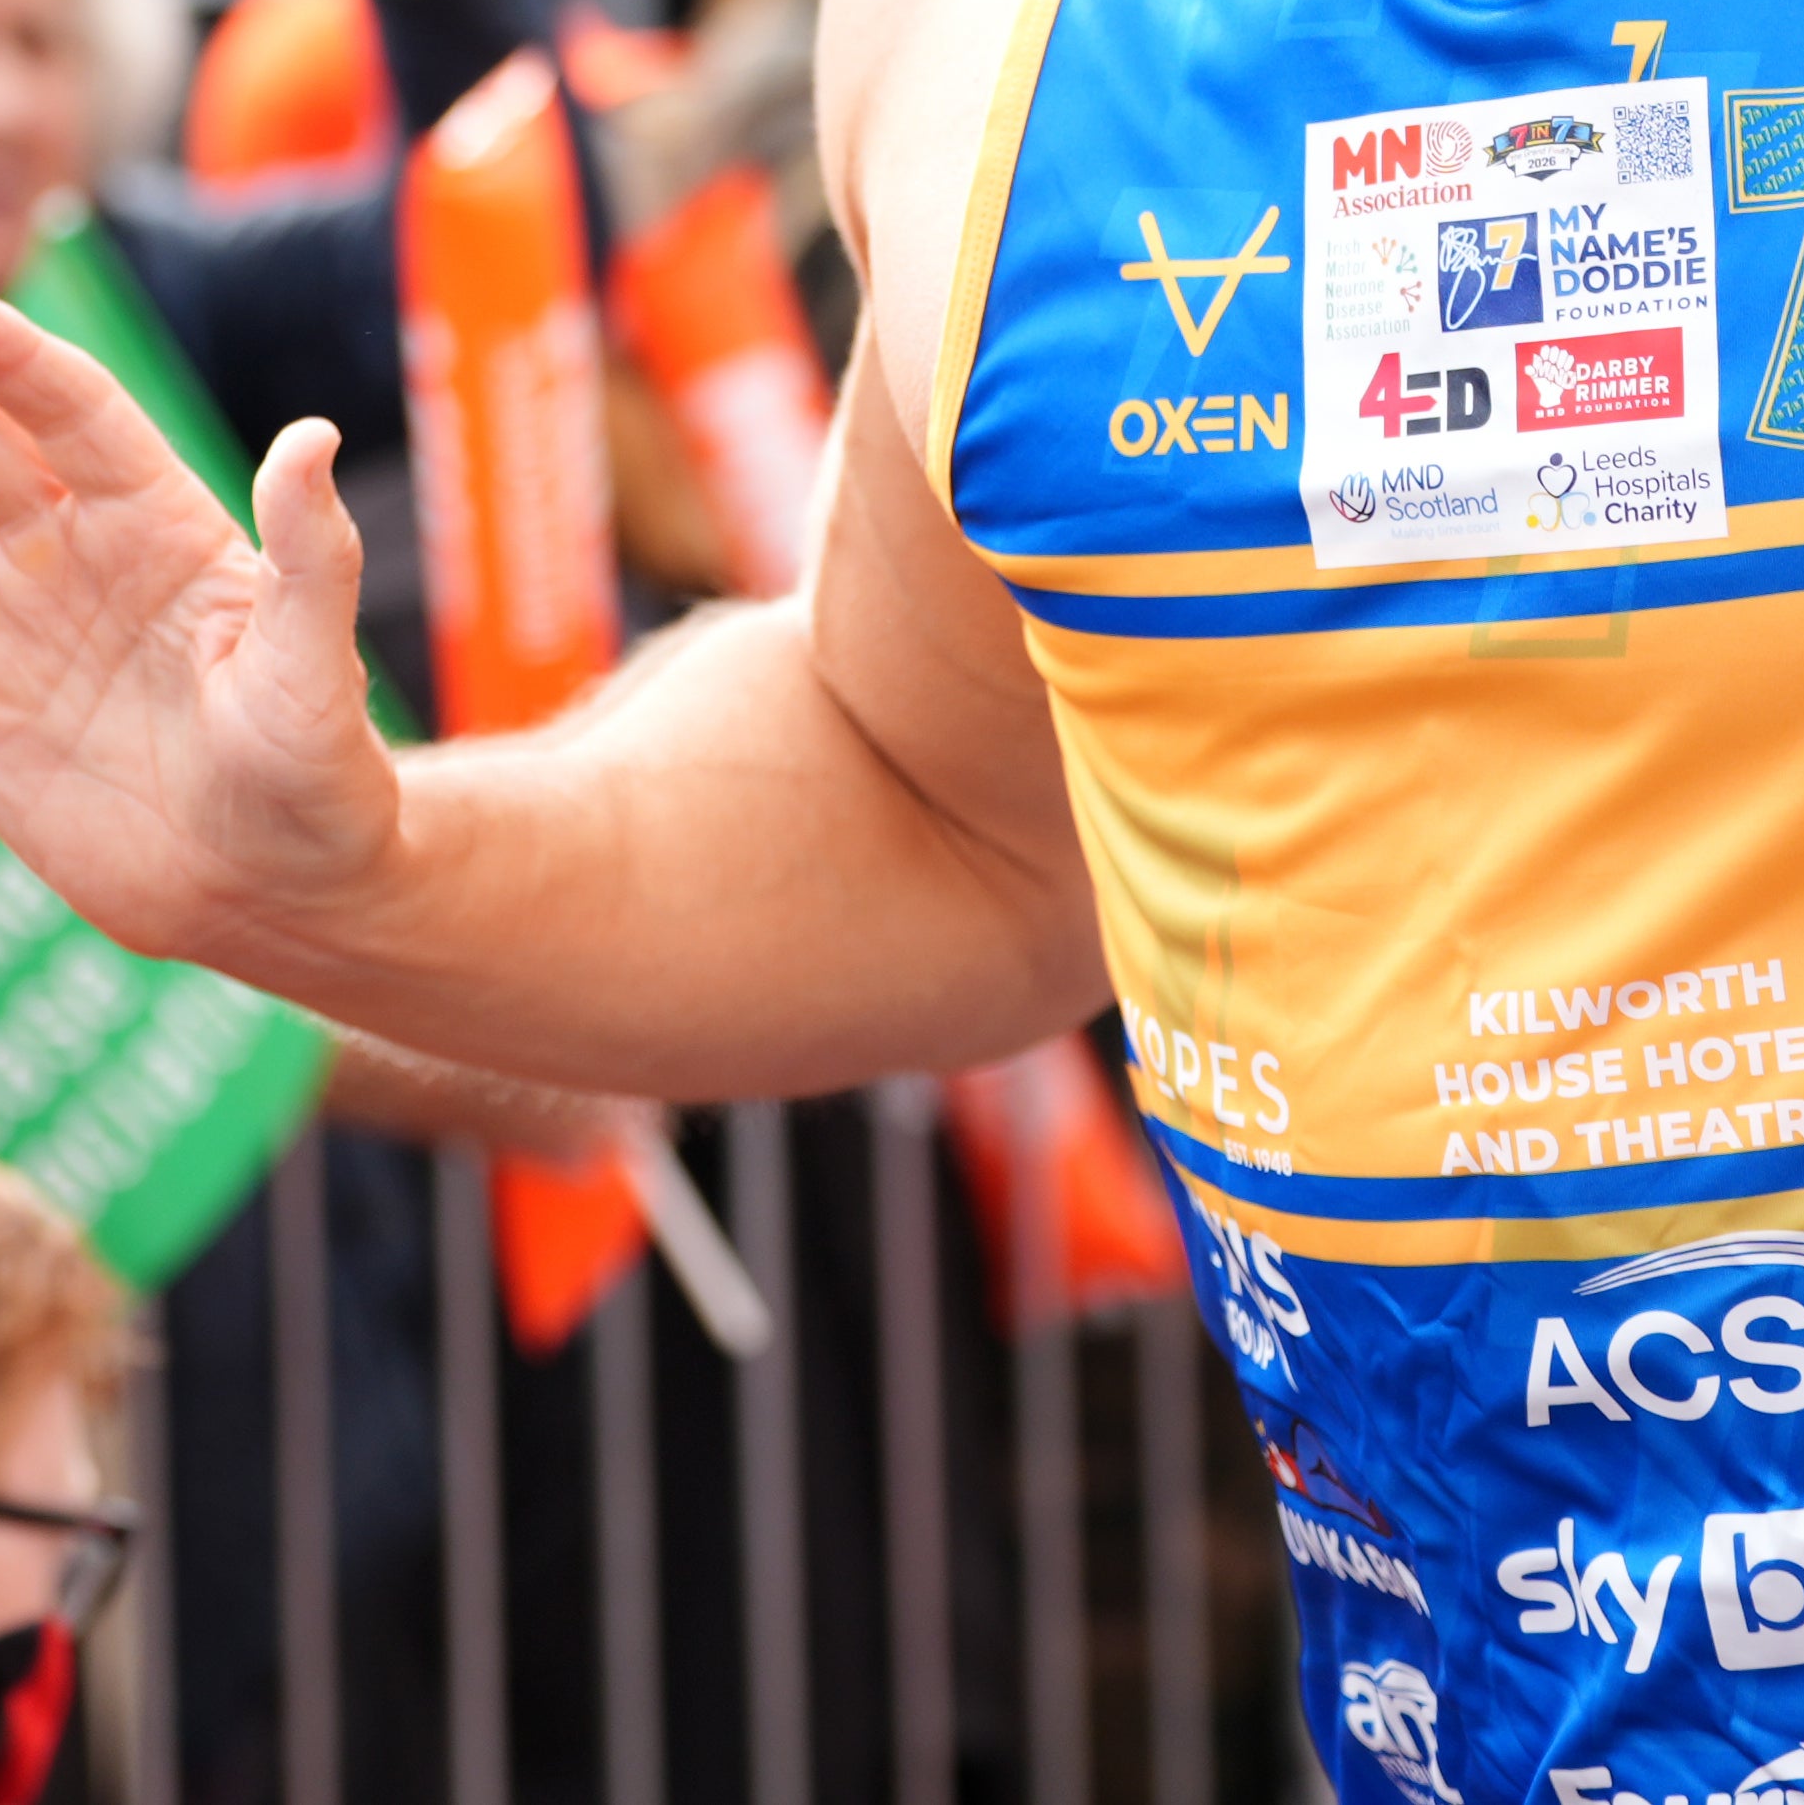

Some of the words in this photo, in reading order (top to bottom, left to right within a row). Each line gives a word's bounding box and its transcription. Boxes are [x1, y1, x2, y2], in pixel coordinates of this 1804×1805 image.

[1510, 124, 1529, 149] 7
[1531, 125, 1550, 139] IN
[1552, 115, 1573, 143] 7
[1333, 121, 1472, 190] MND
[1528, 156, 1556, 169] 2026
[1333, 181, 1473, 219] Association
[1549, 203, 1607, 234] MY
[1326, 238, 1361, 257] Irish
[1484, 218, 1528, 292] 7
[1325, 279, 1385, 300] Neurone
[1553, 257, 1707, 297] DODDIE
[1326, 300, 1383, 320] Disease
[1556, 295, 1708, 321] FOUNDATION
[1326, 317, 1411, 341] Association
[1576, 355, 1654, 381] DARBY
[1576, 375, 1670, 402] RIMMER
[1535, 408, 1565, 419] MND
[1575, 397, 1671, 415] FOUNDATION
[1109, 393, 1289, 457] OXEN
[1582, 445, 1656, 471] Leeds
[1382, 464, 1444, 494] MND
[1595, 468, 1711, 499] Hospitals
[1385, 487, 1499, 521] Scotland
[1605, 496, 1698, 524] Charity
[1469, 958, 1786, 1037] KILWORTH
[1434, 1048, 1627, 1106] HOUSE
[1440, 1127, 1560, 1176] AND
[1497, 1517, 1683, 1674] sky
